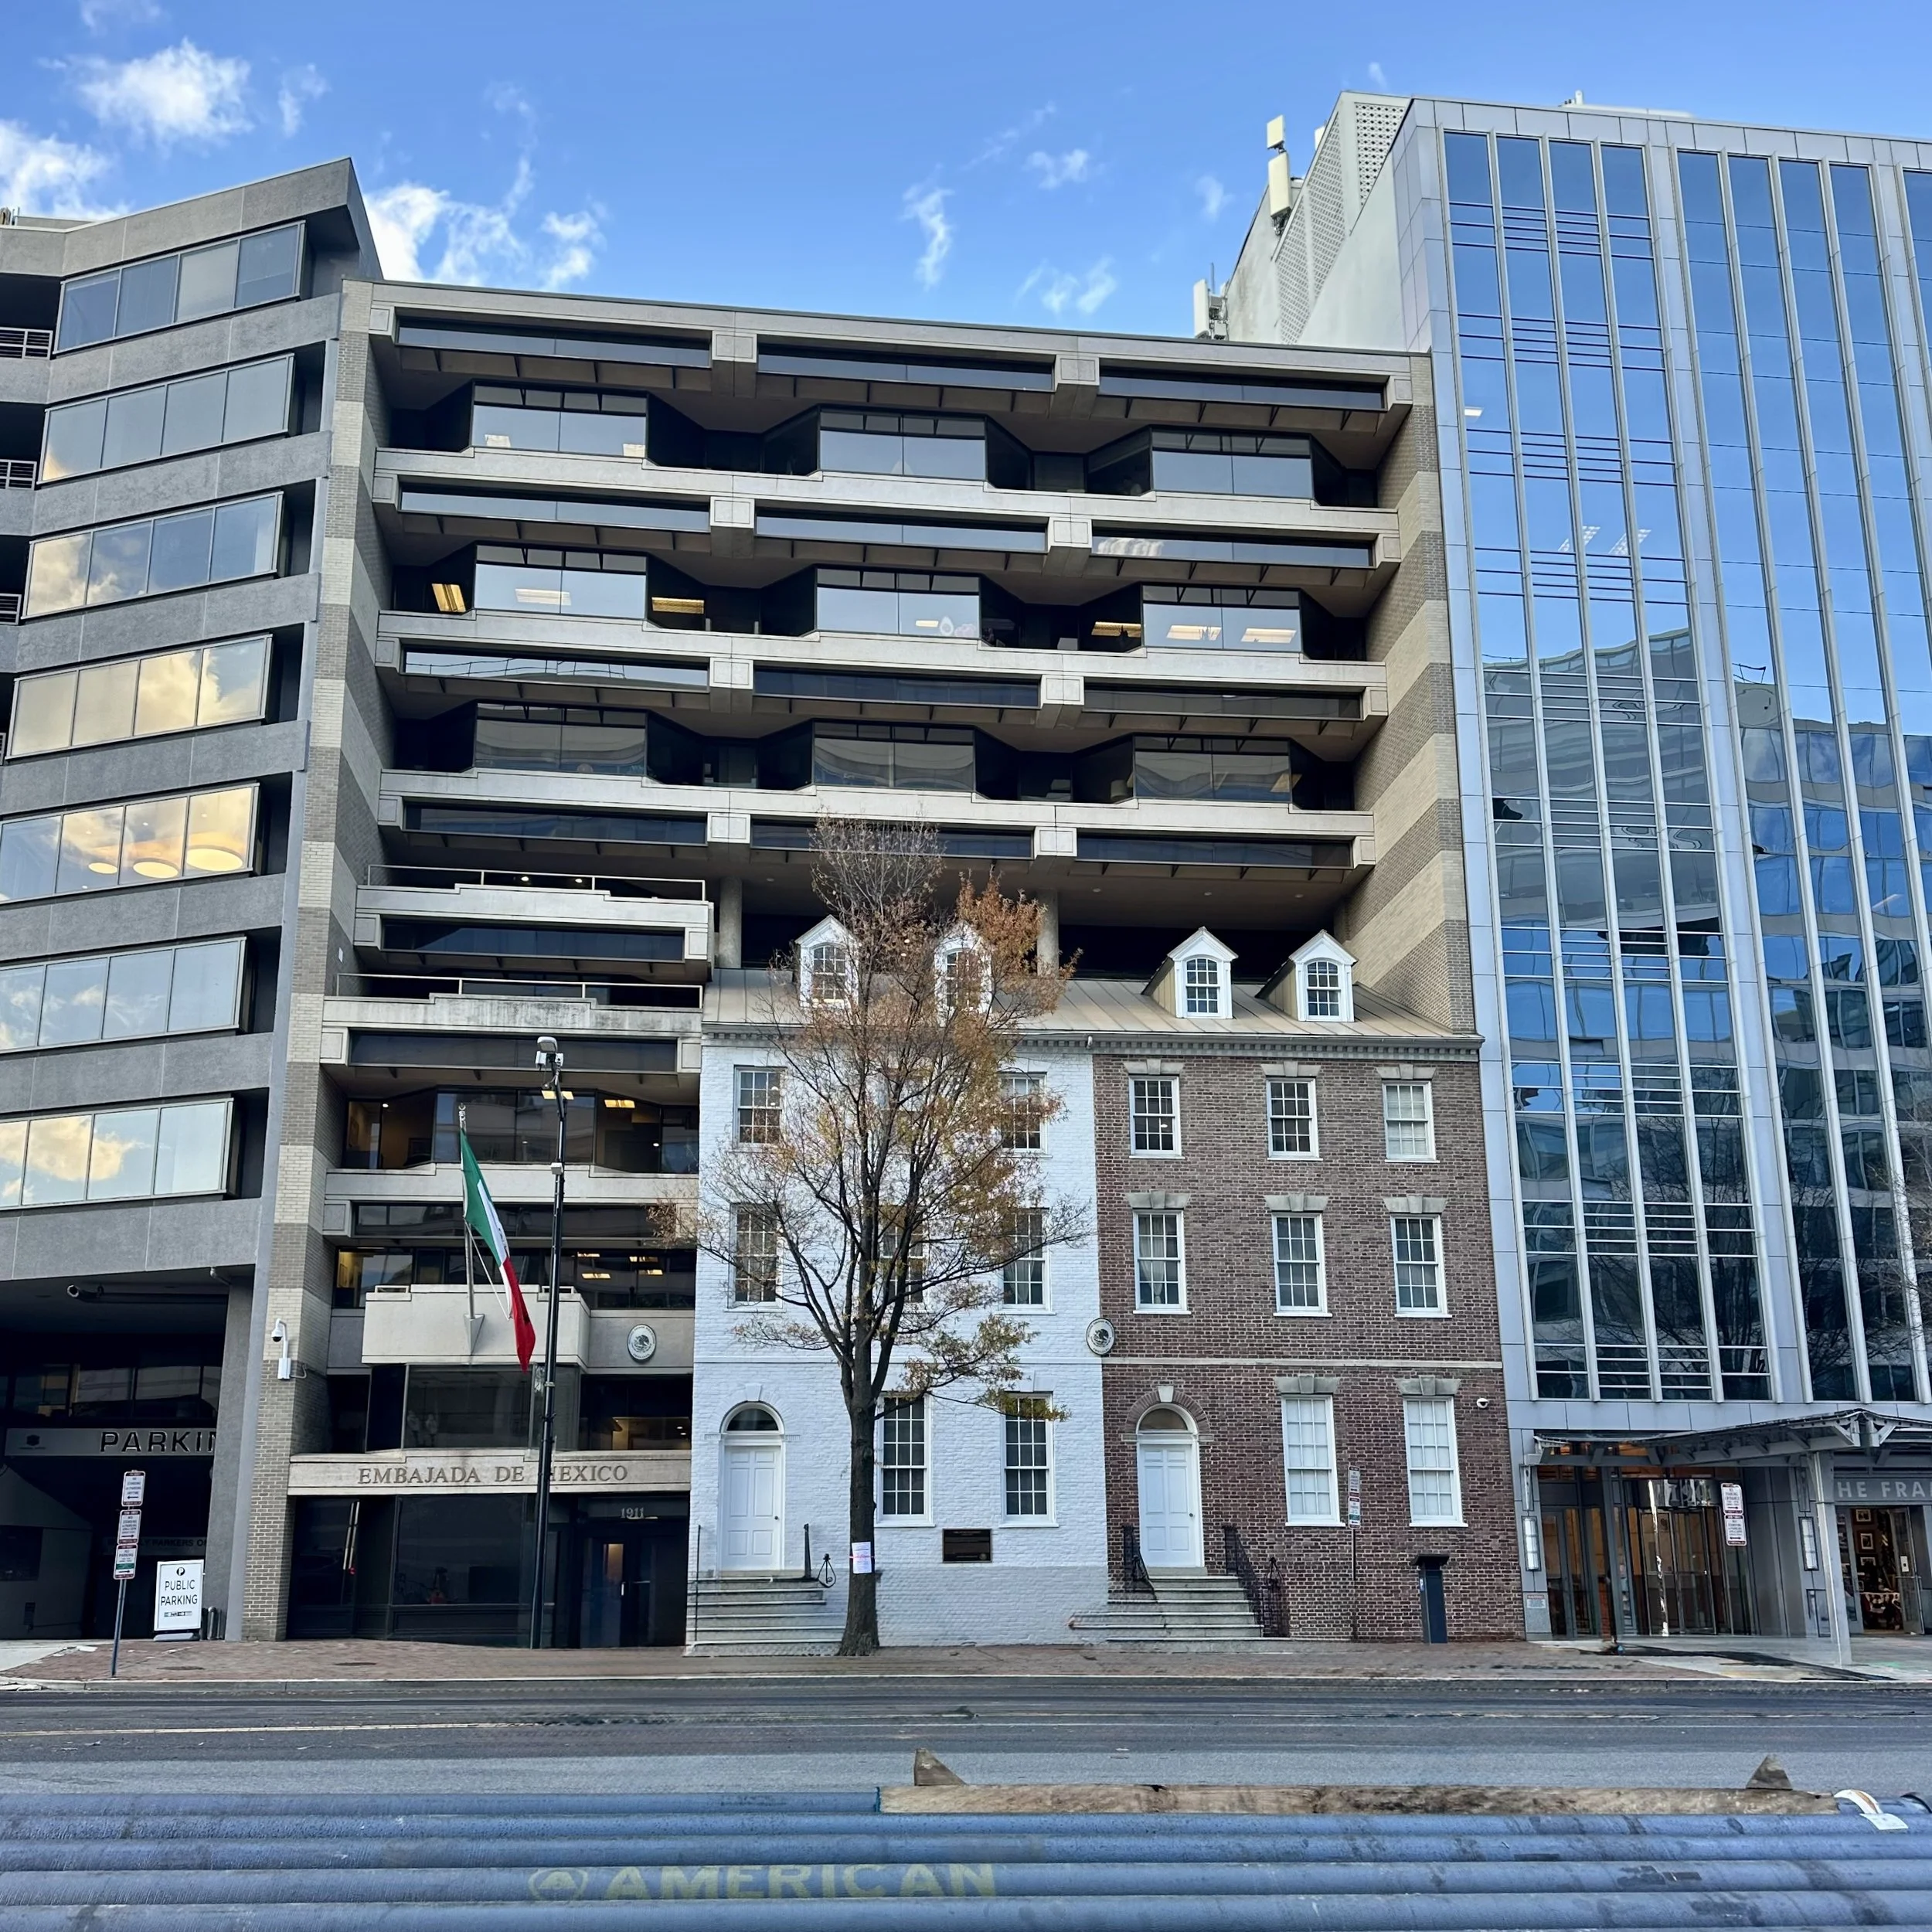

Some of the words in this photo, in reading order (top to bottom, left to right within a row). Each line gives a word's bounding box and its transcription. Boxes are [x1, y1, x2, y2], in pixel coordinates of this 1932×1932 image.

[358, 1467, 481, 1484] EMBAJADA
[495, 1466, 524, 1481] DE
[1881, 1481, 1932, 1498] FRA
[621, 1508, 644, 1519] 1911
[165, 1580, 196, 1590] PUBLIC
[161, 1594, 198, 1606] PARKING
[604, 1863, 996, 1900] AMERICAN
